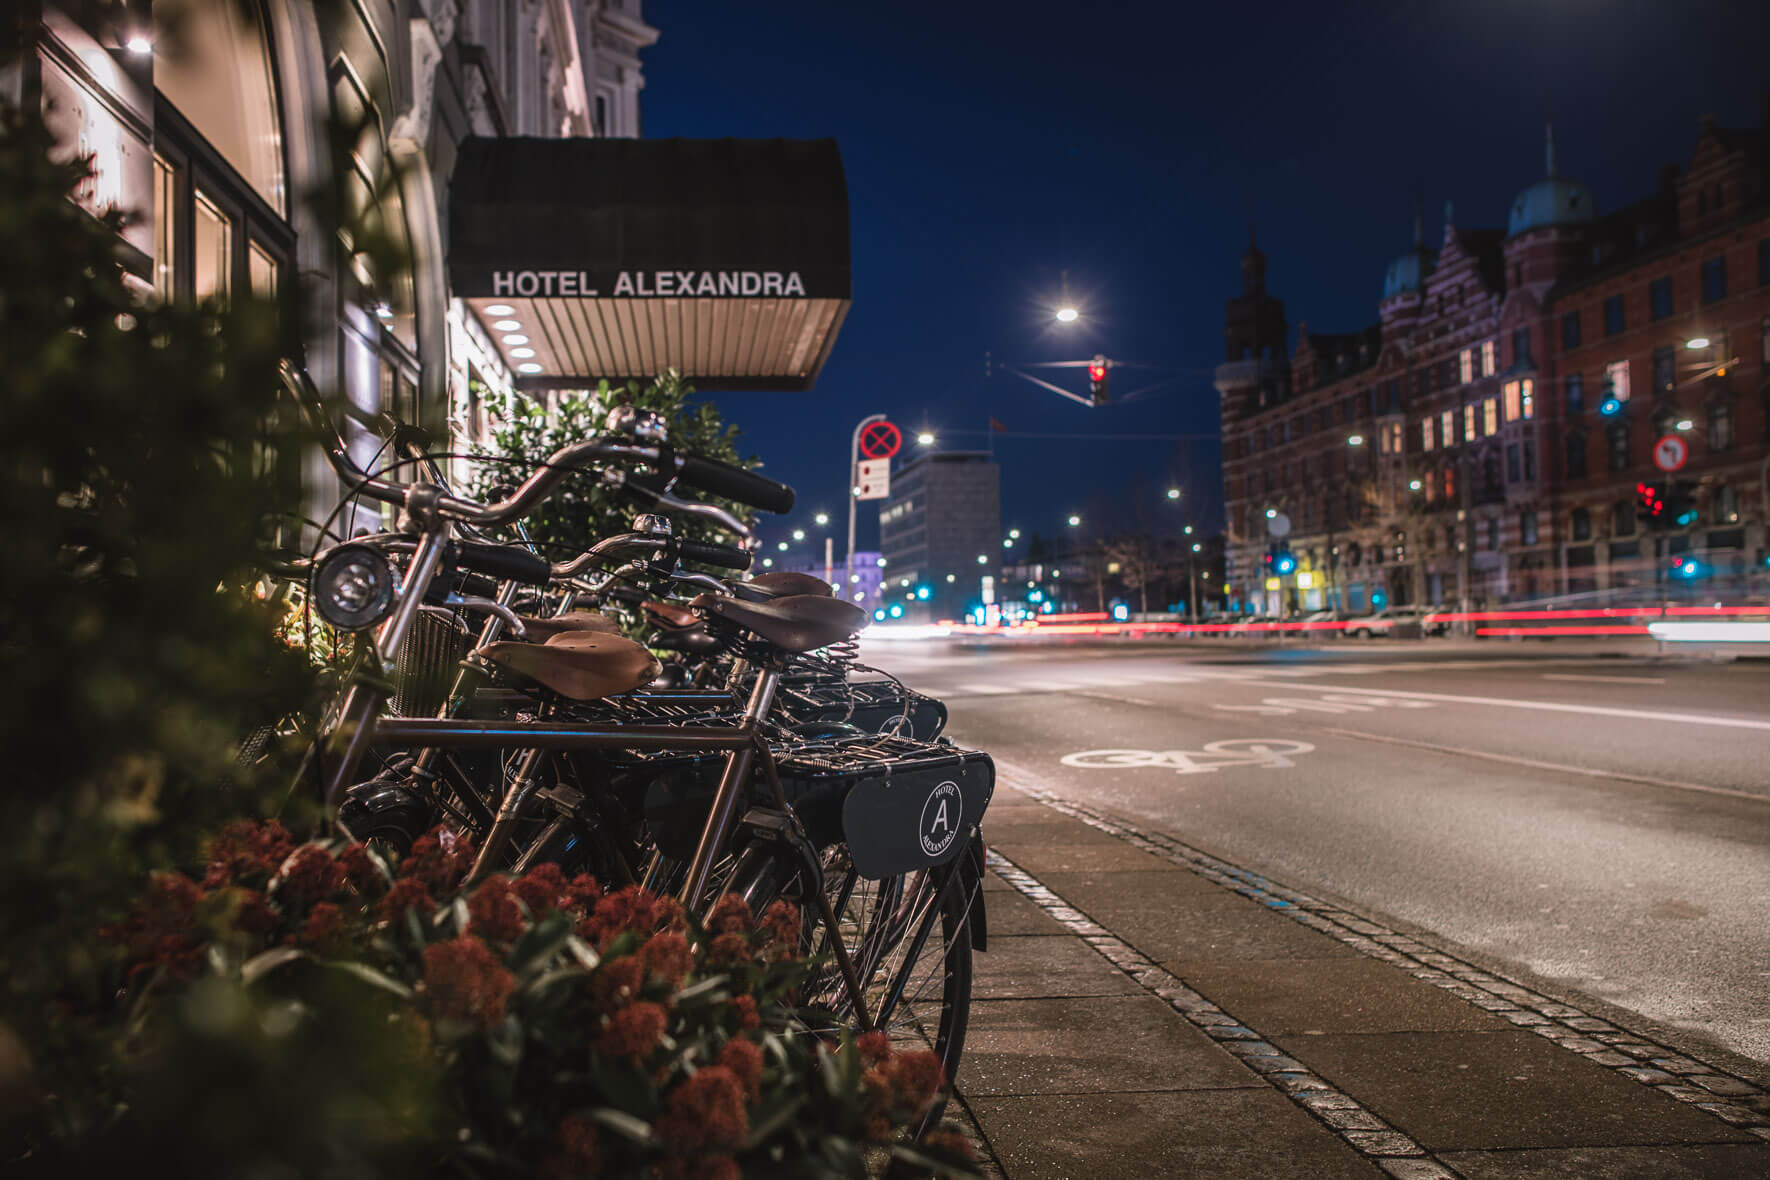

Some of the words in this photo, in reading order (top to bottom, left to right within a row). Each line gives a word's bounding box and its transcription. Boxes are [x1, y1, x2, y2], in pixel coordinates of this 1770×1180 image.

[492, 271, 598, 296] HOTEL
[613, 271, 806, 296] ALEXANDRA
[935, 785, 955, 798] HOTEL
[931, 799, 948, 834] A
